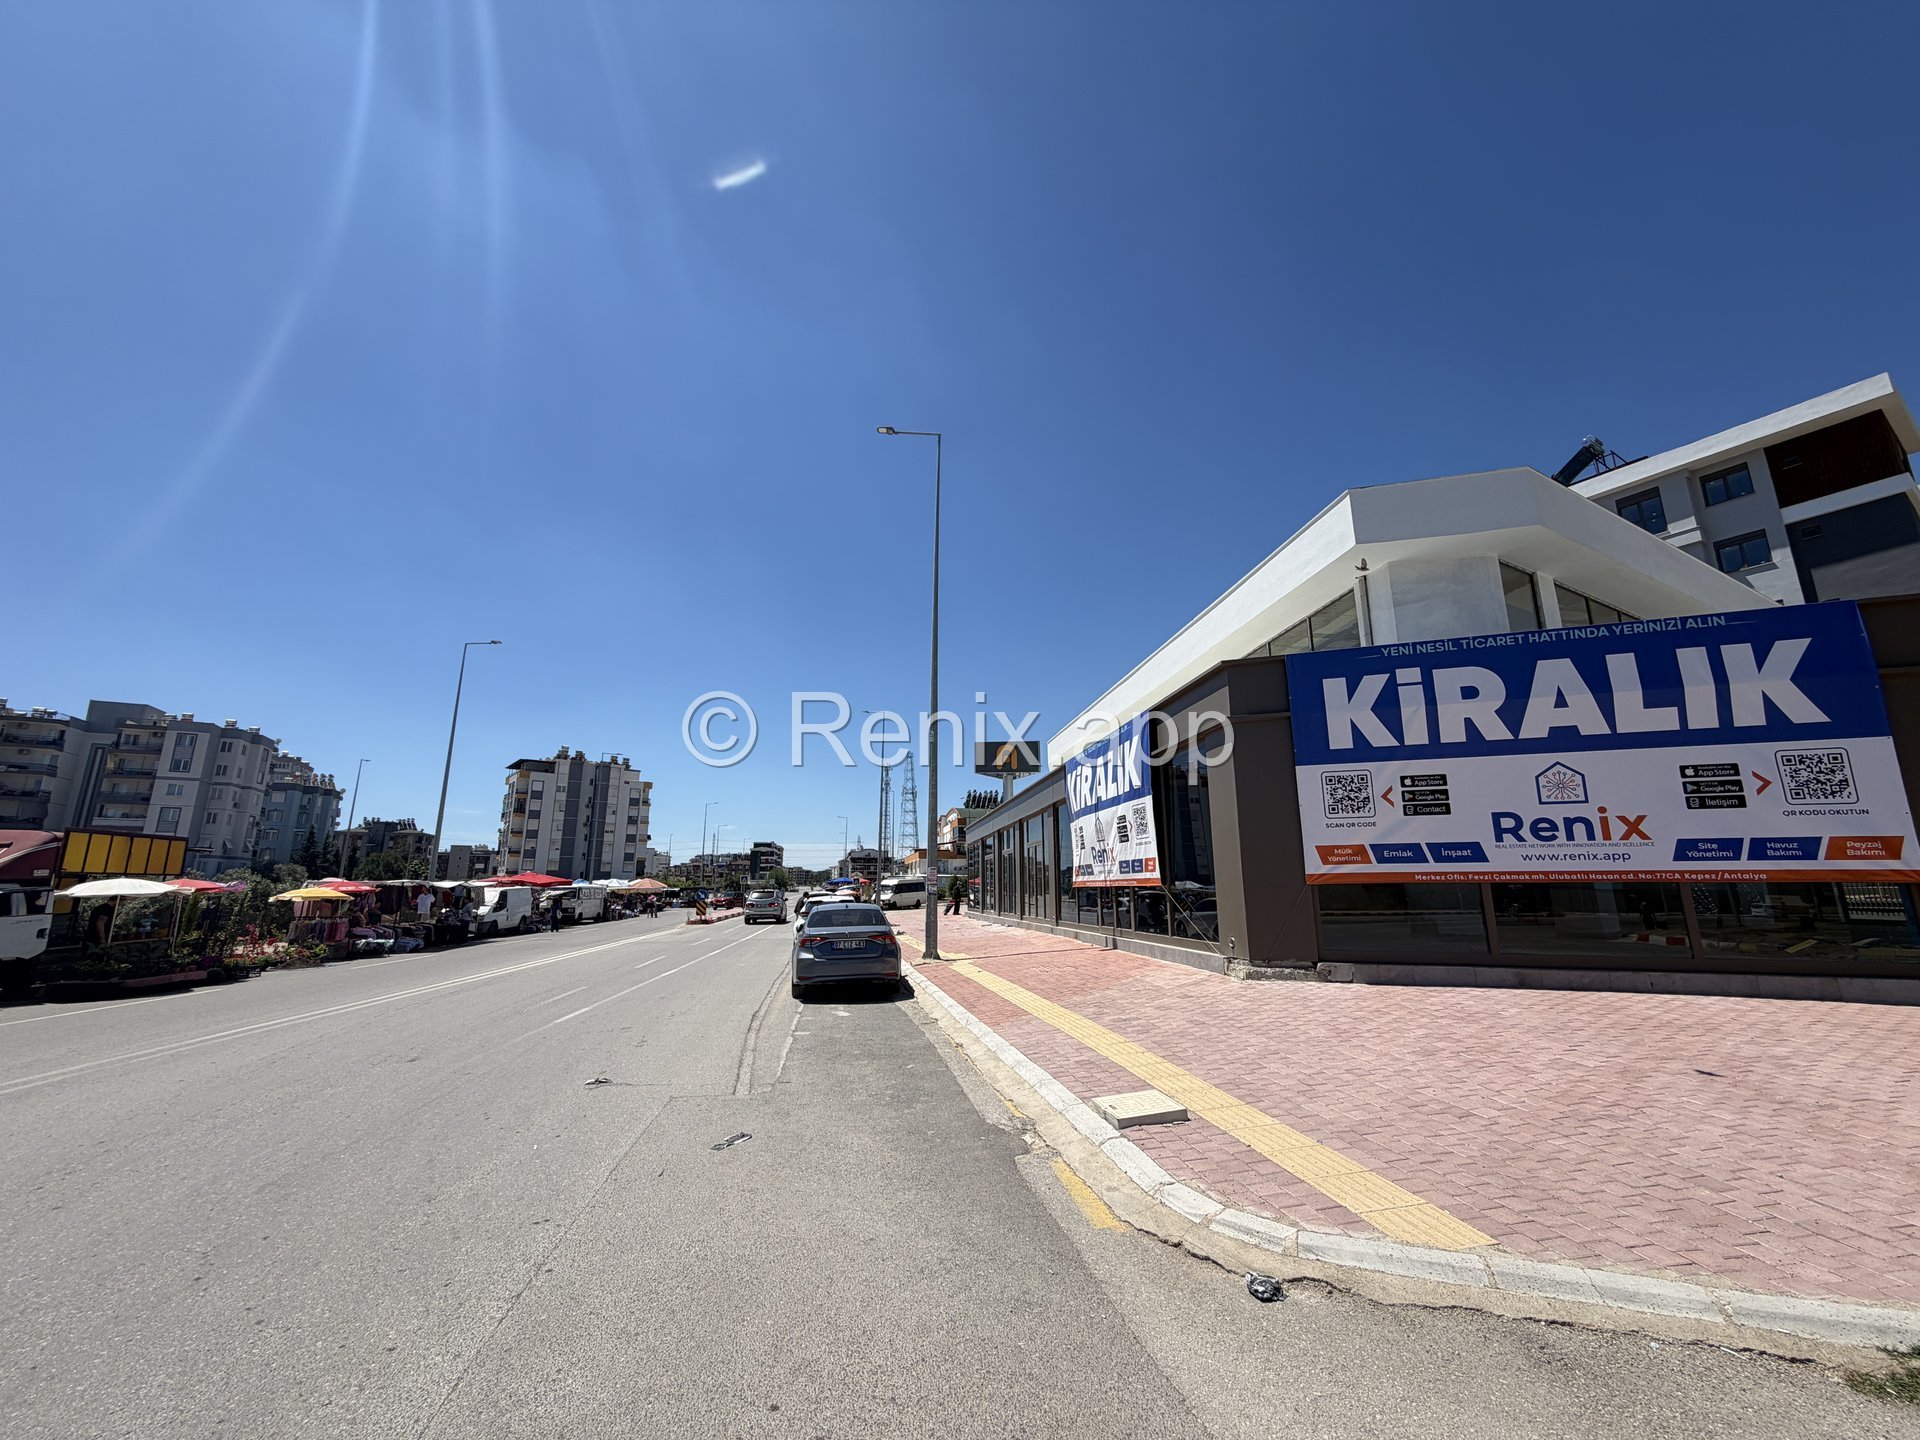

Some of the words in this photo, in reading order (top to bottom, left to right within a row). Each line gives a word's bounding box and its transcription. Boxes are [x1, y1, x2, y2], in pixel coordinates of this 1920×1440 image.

[1381, 643, 1413, 657] YENİ
[1416, 639, 1457, 654] NESİL
[1460, 634, 1525, 649] TİCARET
[1529, 625, 1610, 643] HATTINDA
[1612, 617, 1682, 636] YERİNİZİ
[1685, 615, 1726, 630] ALIN
[1828, 808, 1870, 816] OKUTUN
[1491, 805, 1653, 843] Renix
[1697, 841, 1719, 850] Site
[1766, 841, 1799, 849] Havuz
[1846, 840, 1883, 850] Peyzaj
[1383, 849, 1414, 858] Emlak
[1441, 847, 1472, 858] İnşaat
[1521, 850, 1632, 863] www.renix.app
[1686, 848, 1734, 858] Yönetimi
[1327, 854, 1362, 862] Yönetimi
[1446, 873, 1468, 881] Ofis:
[1493, 873, 1530, 881] Çakmak
